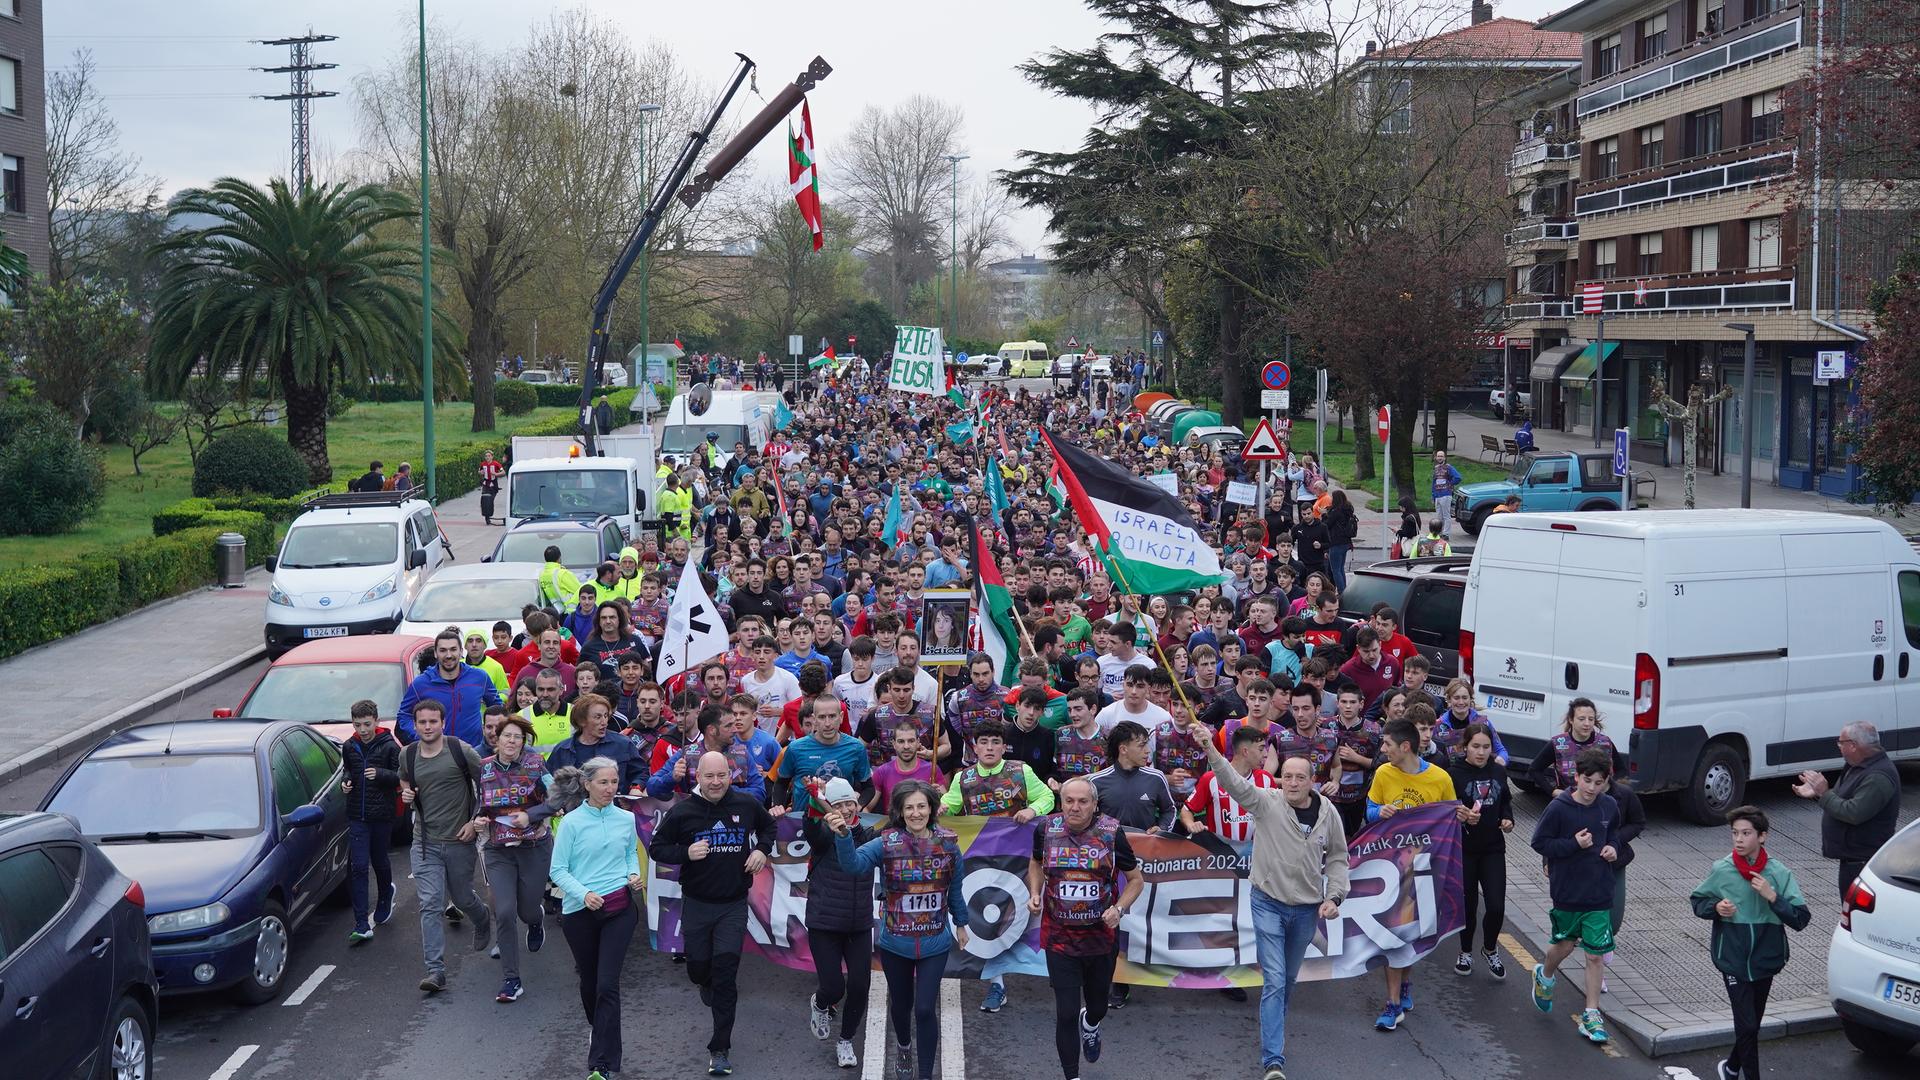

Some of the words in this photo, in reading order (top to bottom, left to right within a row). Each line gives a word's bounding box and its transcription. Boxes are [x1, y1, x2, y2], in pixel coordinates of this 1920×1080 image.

[1114, 510, 1196, 543] ISRAELI
[1674, 584, 1685, 596] 31
[310, 628, 329, 637] 1924
[1499, 673, 1525, 681] PEUGEOT
[1609, 688, 1630, 697] BOXER
[1492, 697, 1515, 710] 5081
[1517, 701, 1537, 713] JVH
[1395, 832, 1432, 849] 24ra
[1060, 884, 1099, 897] 1718
[909, 894, 938, 910] 1718
